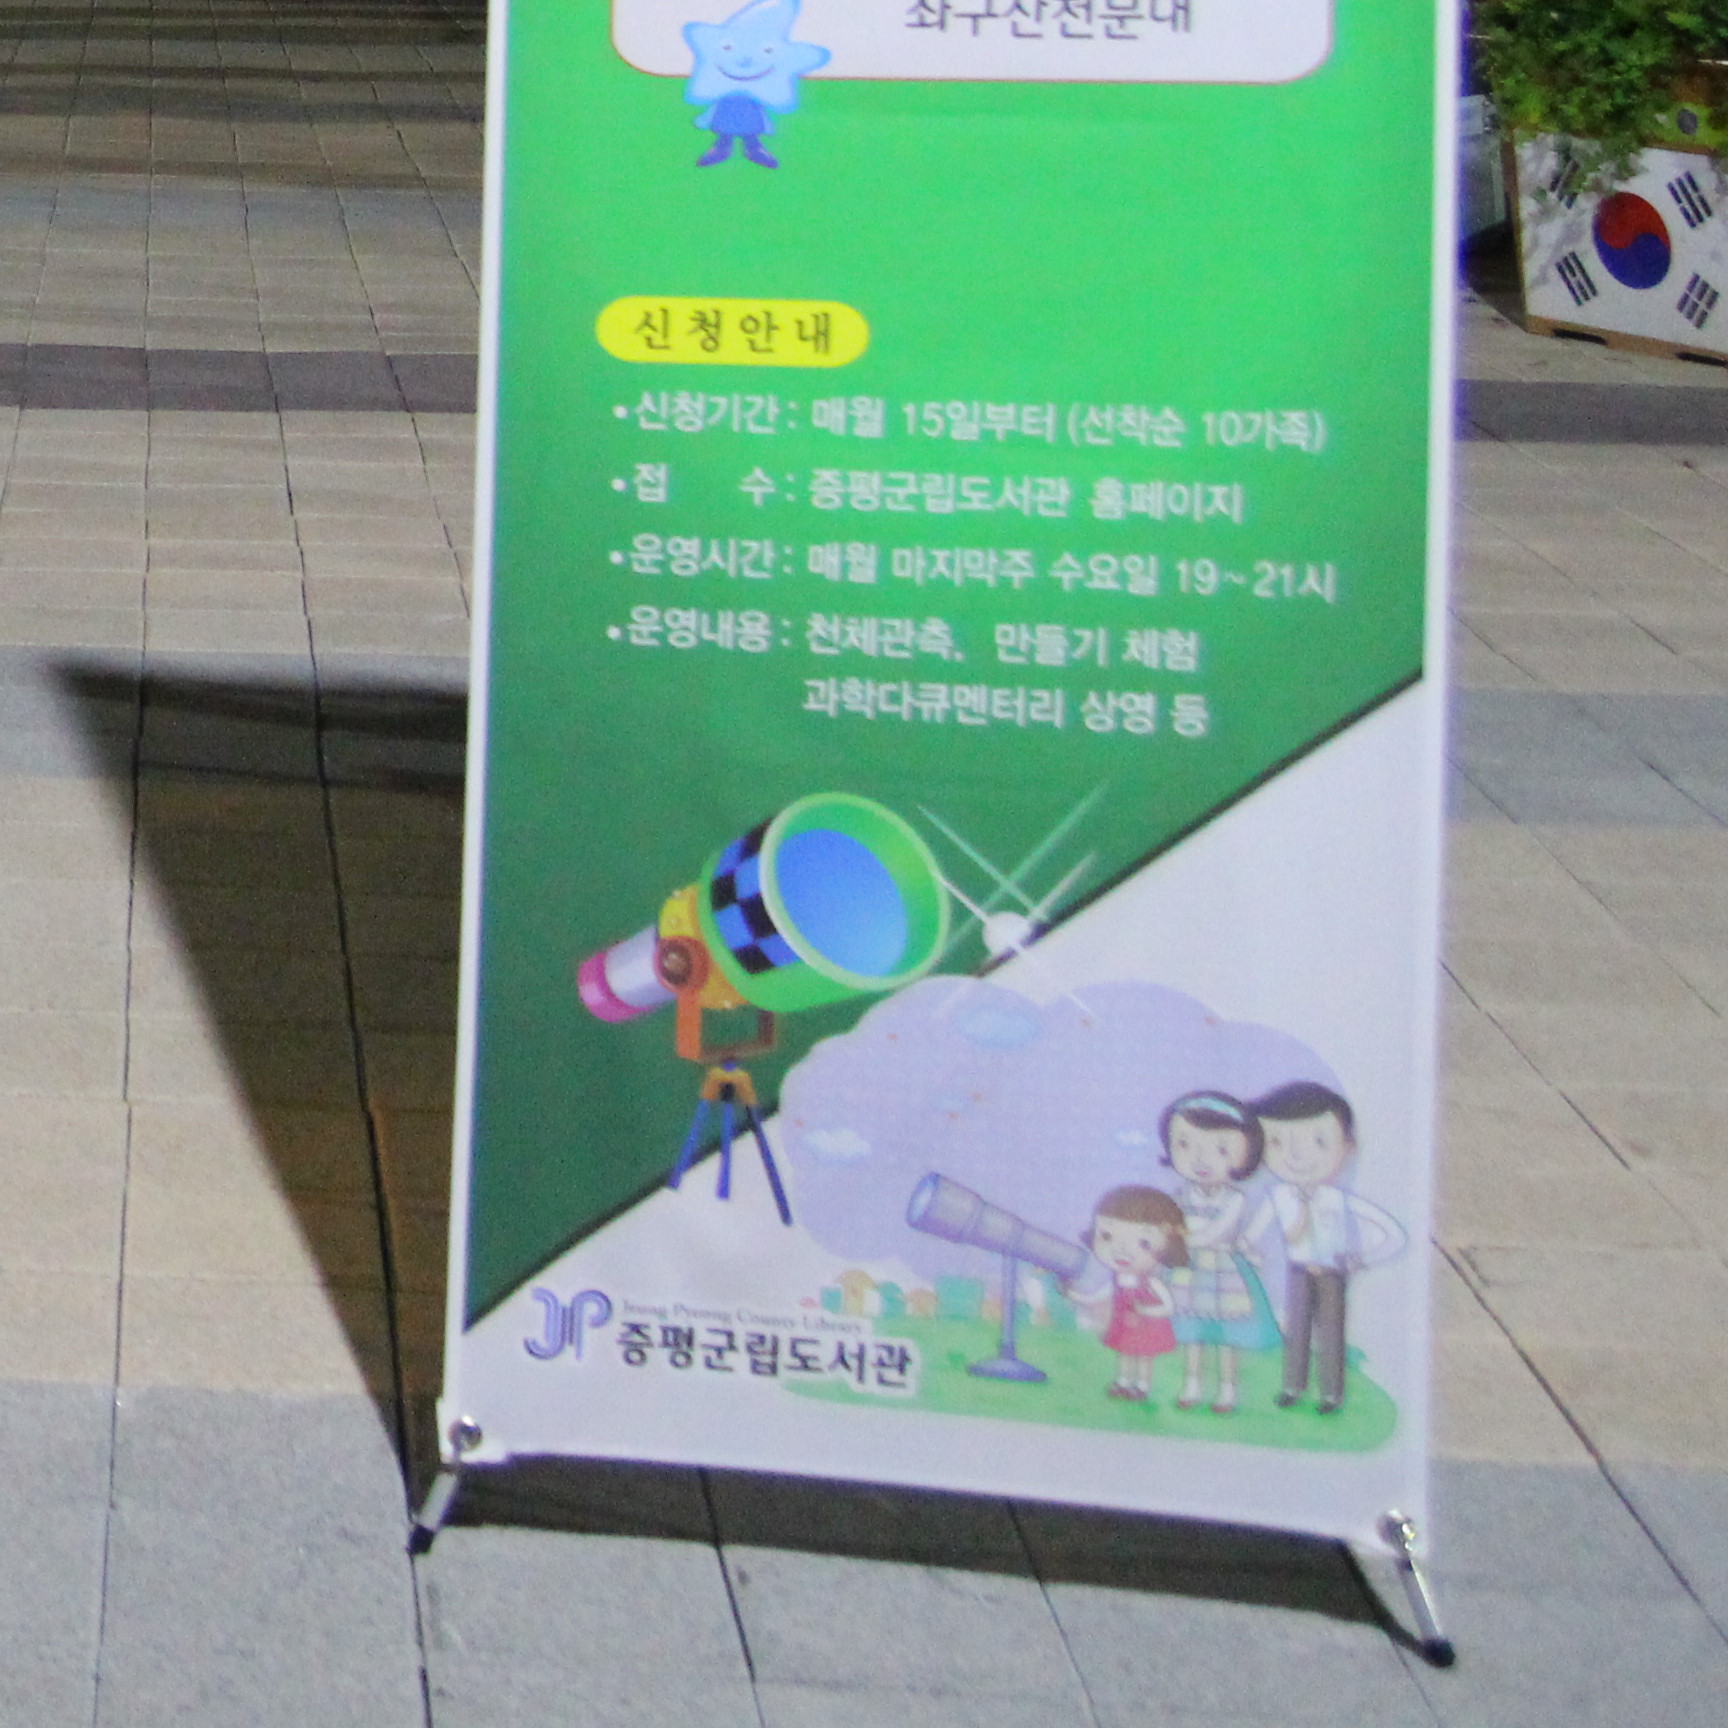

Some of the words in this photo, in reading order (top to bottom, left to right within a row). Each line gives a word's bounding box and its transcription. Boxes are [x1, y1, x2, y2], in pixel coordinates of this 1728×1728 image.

[811, 394, 887, 439] 매월
[902, 400, 1057, 443] 15일부터
[808, 467, 1072, 518] 증평군립도서관
[1088, 476, 1244, 525] 홈페이지
[807, 540, 880, 585] 매월
[892, 545, 1035, 590] 마지막주
[1048, 551, 1161, 597] 수요일
[993, 622, 1109, 668] 만들기
[1121, 626, 1201, 672] 체험
[801, 676, 1066, 728] 과학다큐멘터리
[1079, 688, 1157, 735] 상영
[1169, 692, 1211, 738] 등
[615, 1319, 912, 1388] 증평군립도서관
